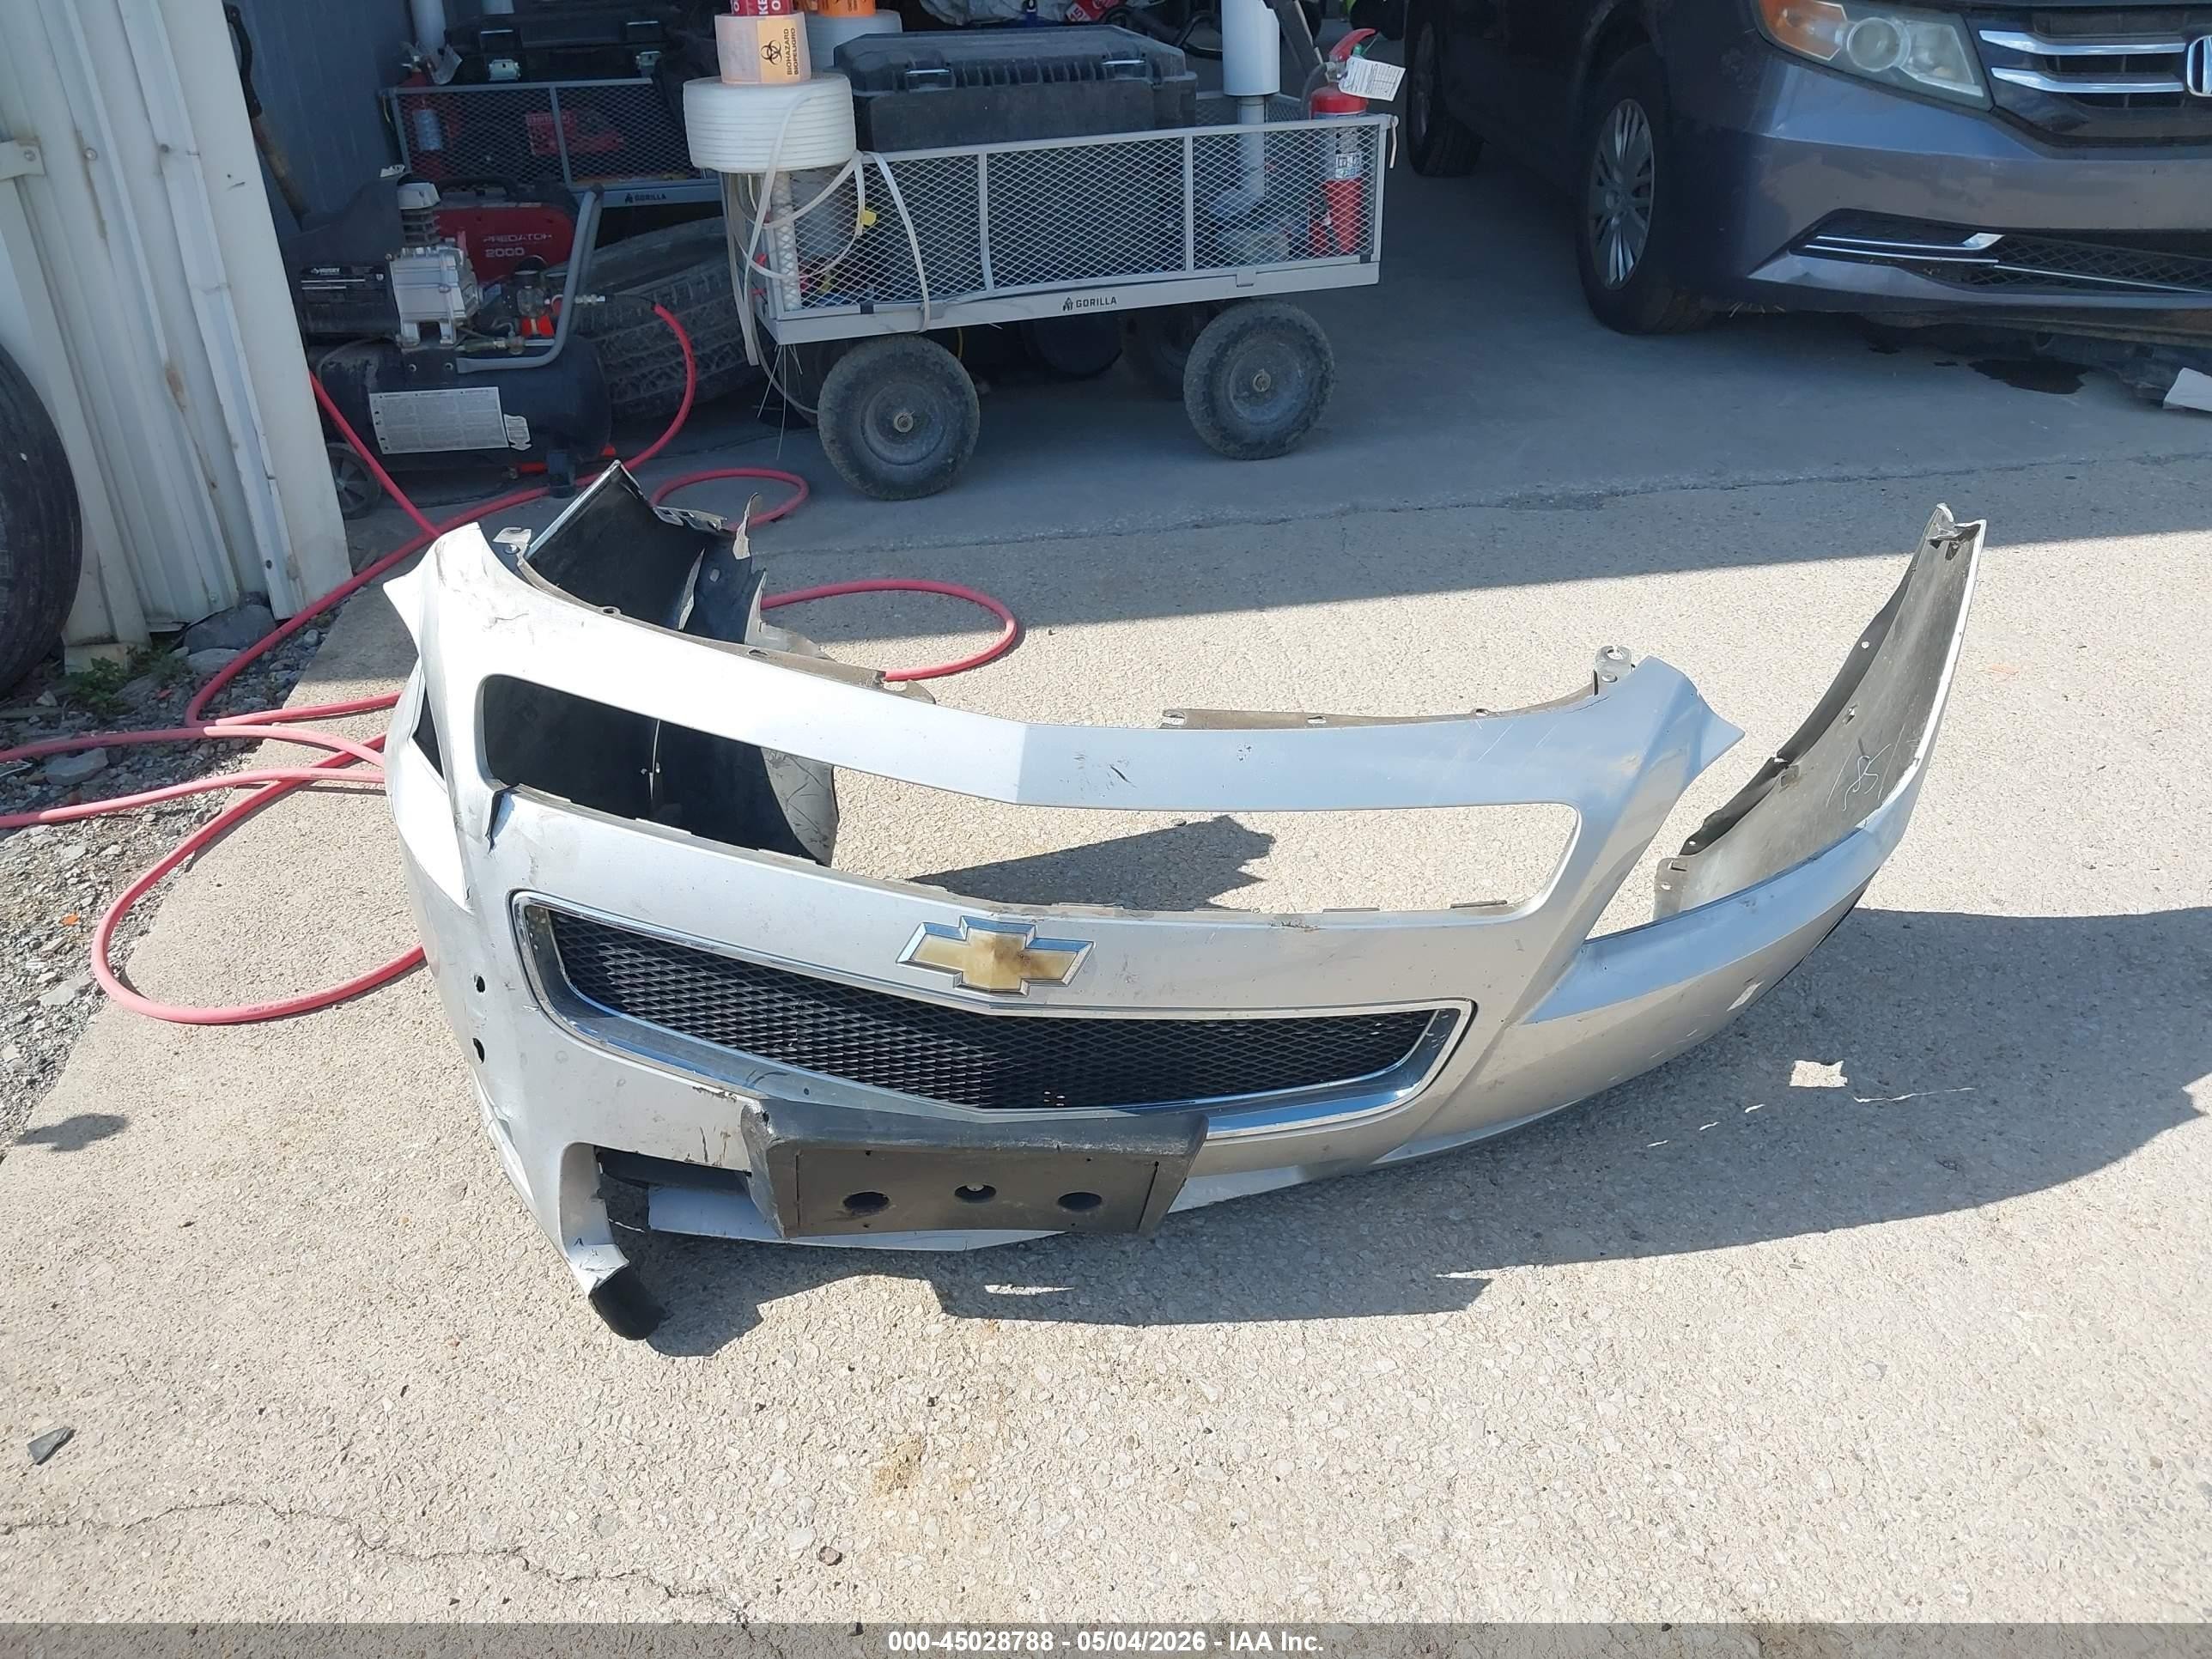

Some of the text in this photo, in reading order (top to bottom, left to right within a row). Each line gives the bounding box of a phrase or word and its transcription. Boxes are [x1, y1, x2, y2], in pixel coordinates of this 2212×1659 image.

[783, 28, 793, 76] BIOHAZARD
[790, 27, 799, 76] BIOPELIGRO
[485, 247, 525, 258] 2000
[1076, 296, 1117, 308] GORILLA
